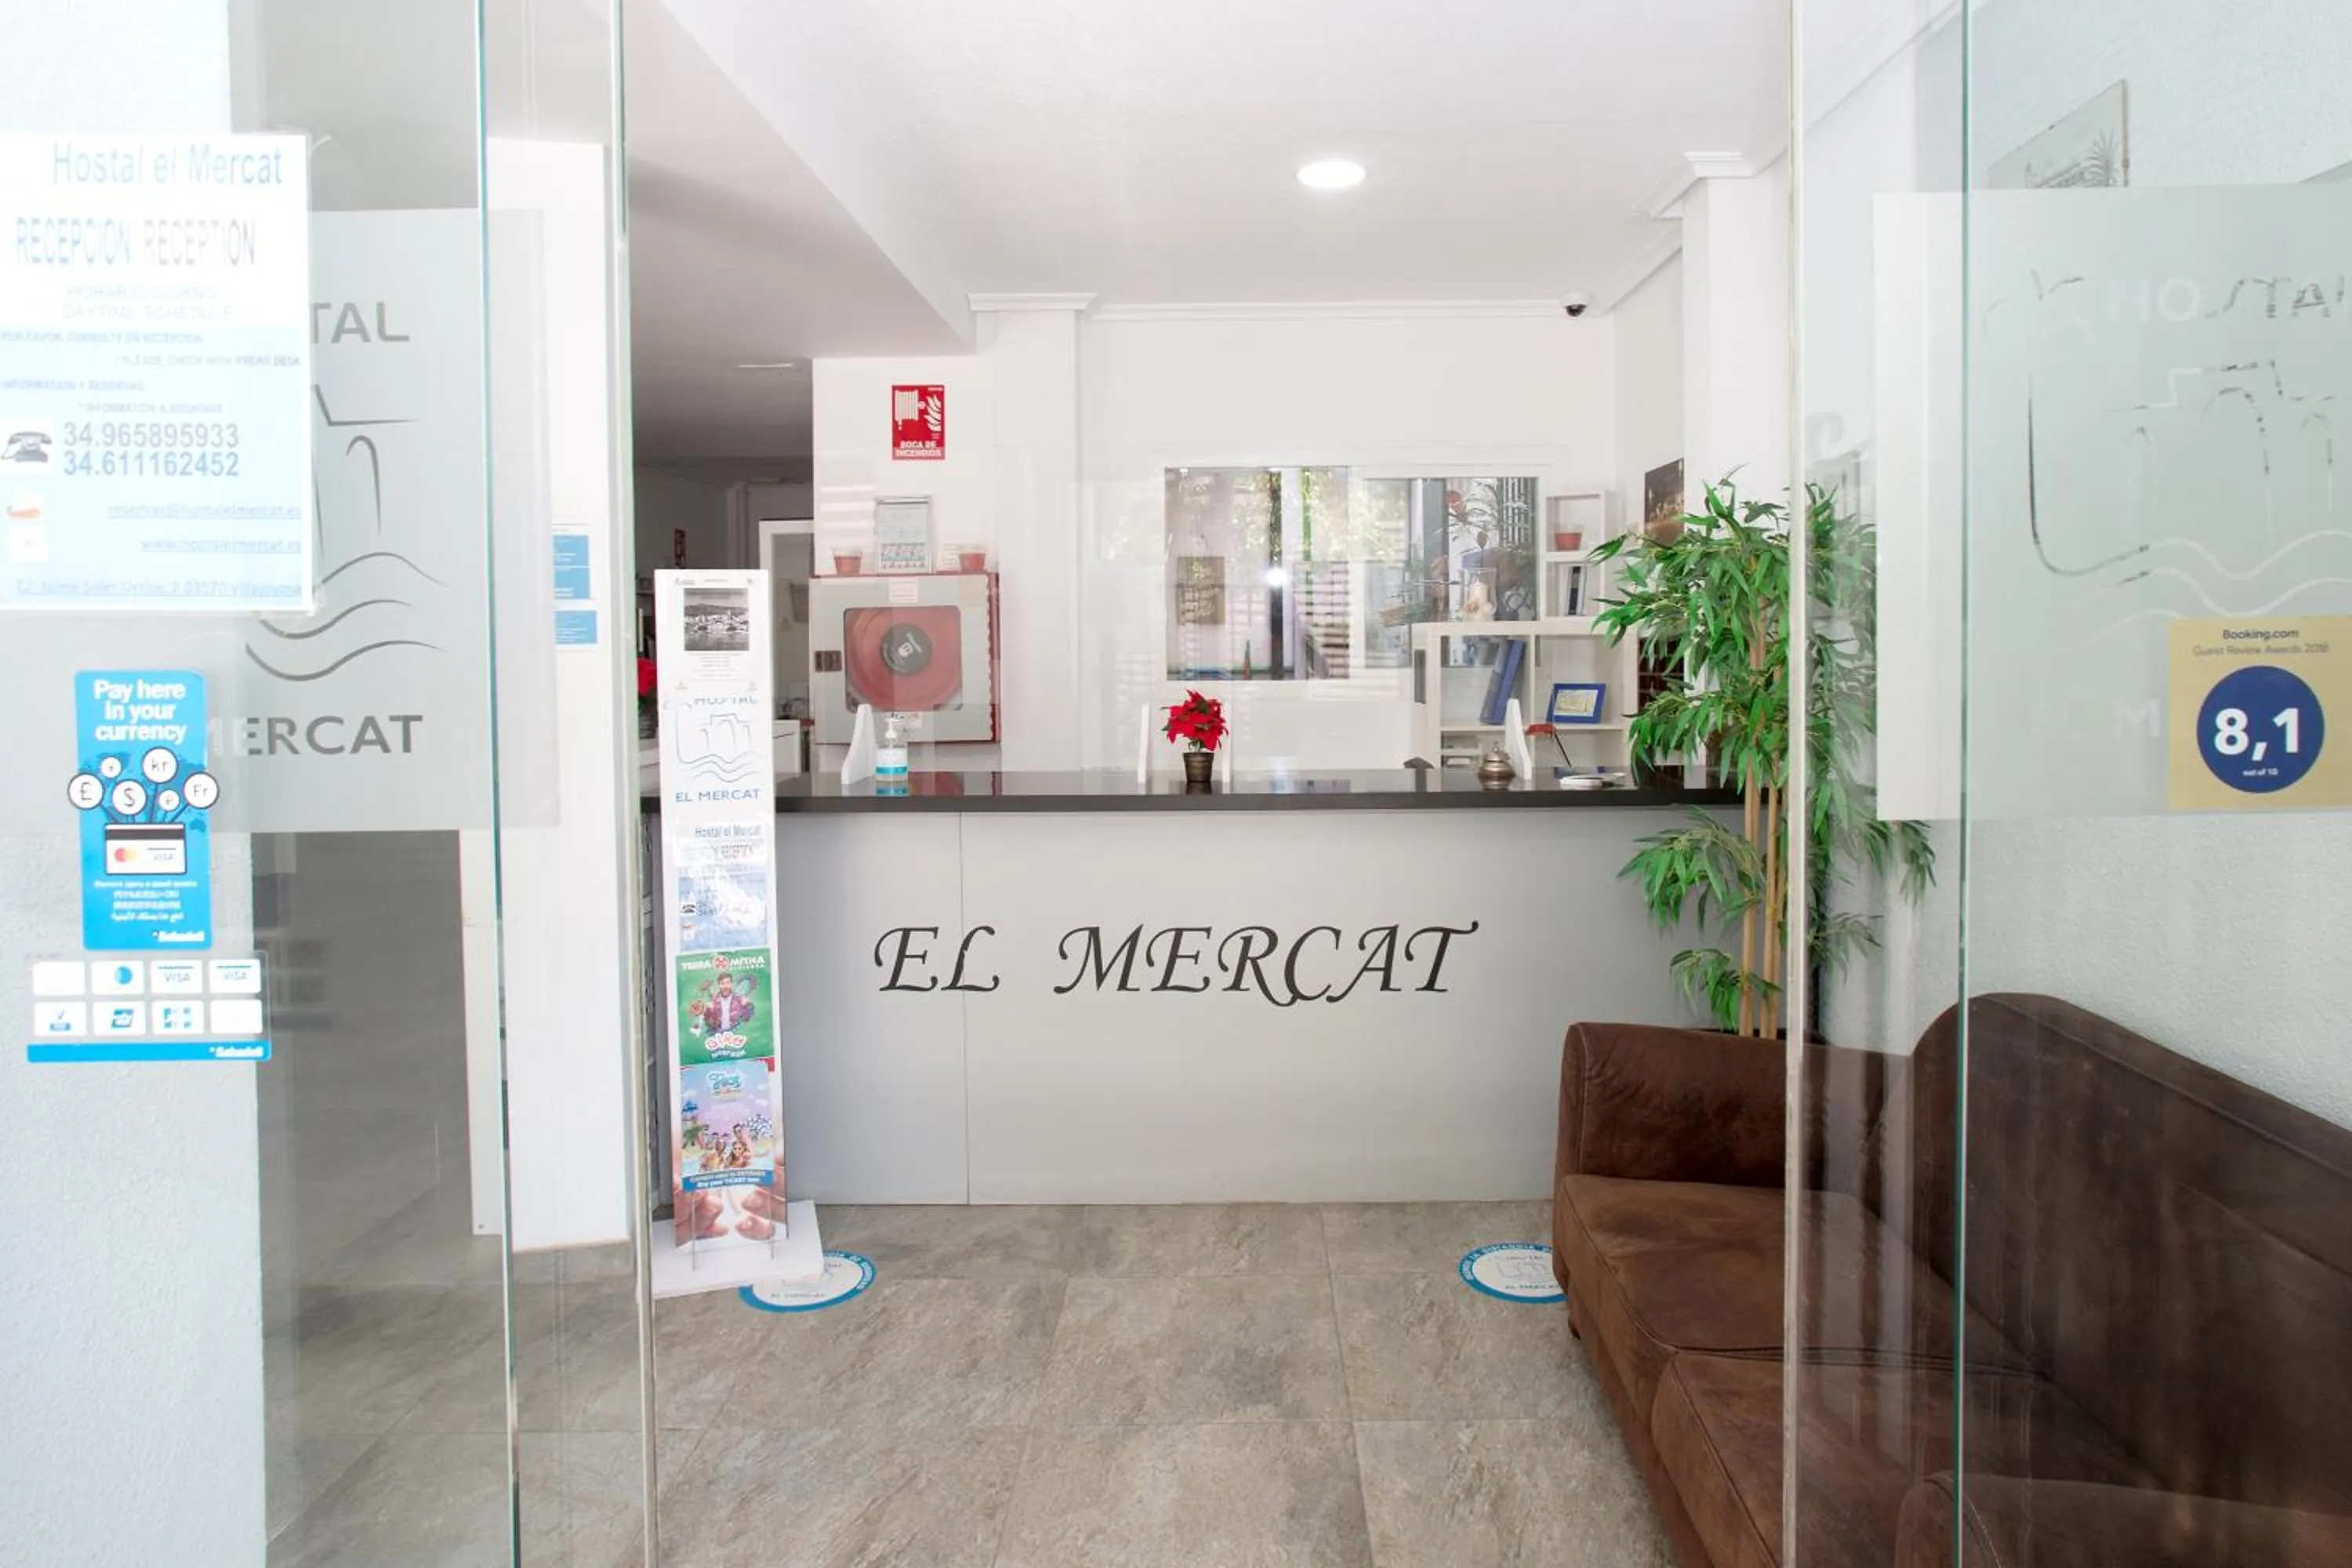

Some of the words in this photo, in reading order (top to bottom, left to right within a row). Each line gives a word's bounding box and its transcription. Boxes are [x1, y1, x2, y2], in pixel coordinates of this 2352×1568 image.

[53, 141, 143, 185] Hostal
[154, 144, 177, 184] el
[189, 143, 283, 185] Mercat
[143, 218, 256, 267] RECEPTION
[310, 301, 410, 343] TAL
[64, 422, 239, 448] 34.965895933
[64, 450, 239, 476] 34.611162452
[2223, 630, 2299, 641] Booking.com
[94, 680, 132, 703] Pay
[136, 678, 186, 699] here
[129, 704, 176, 724] your
[95, 725, 187, 745] currency
[2213, 707, 2299, 761] 8,1
[676, 792, 693, 802] EL
[699, 789, 761, 802] MERCAT
[874, 926, 1000, 992] EL
[1054, 921, 1479, 1007] MERCAT
